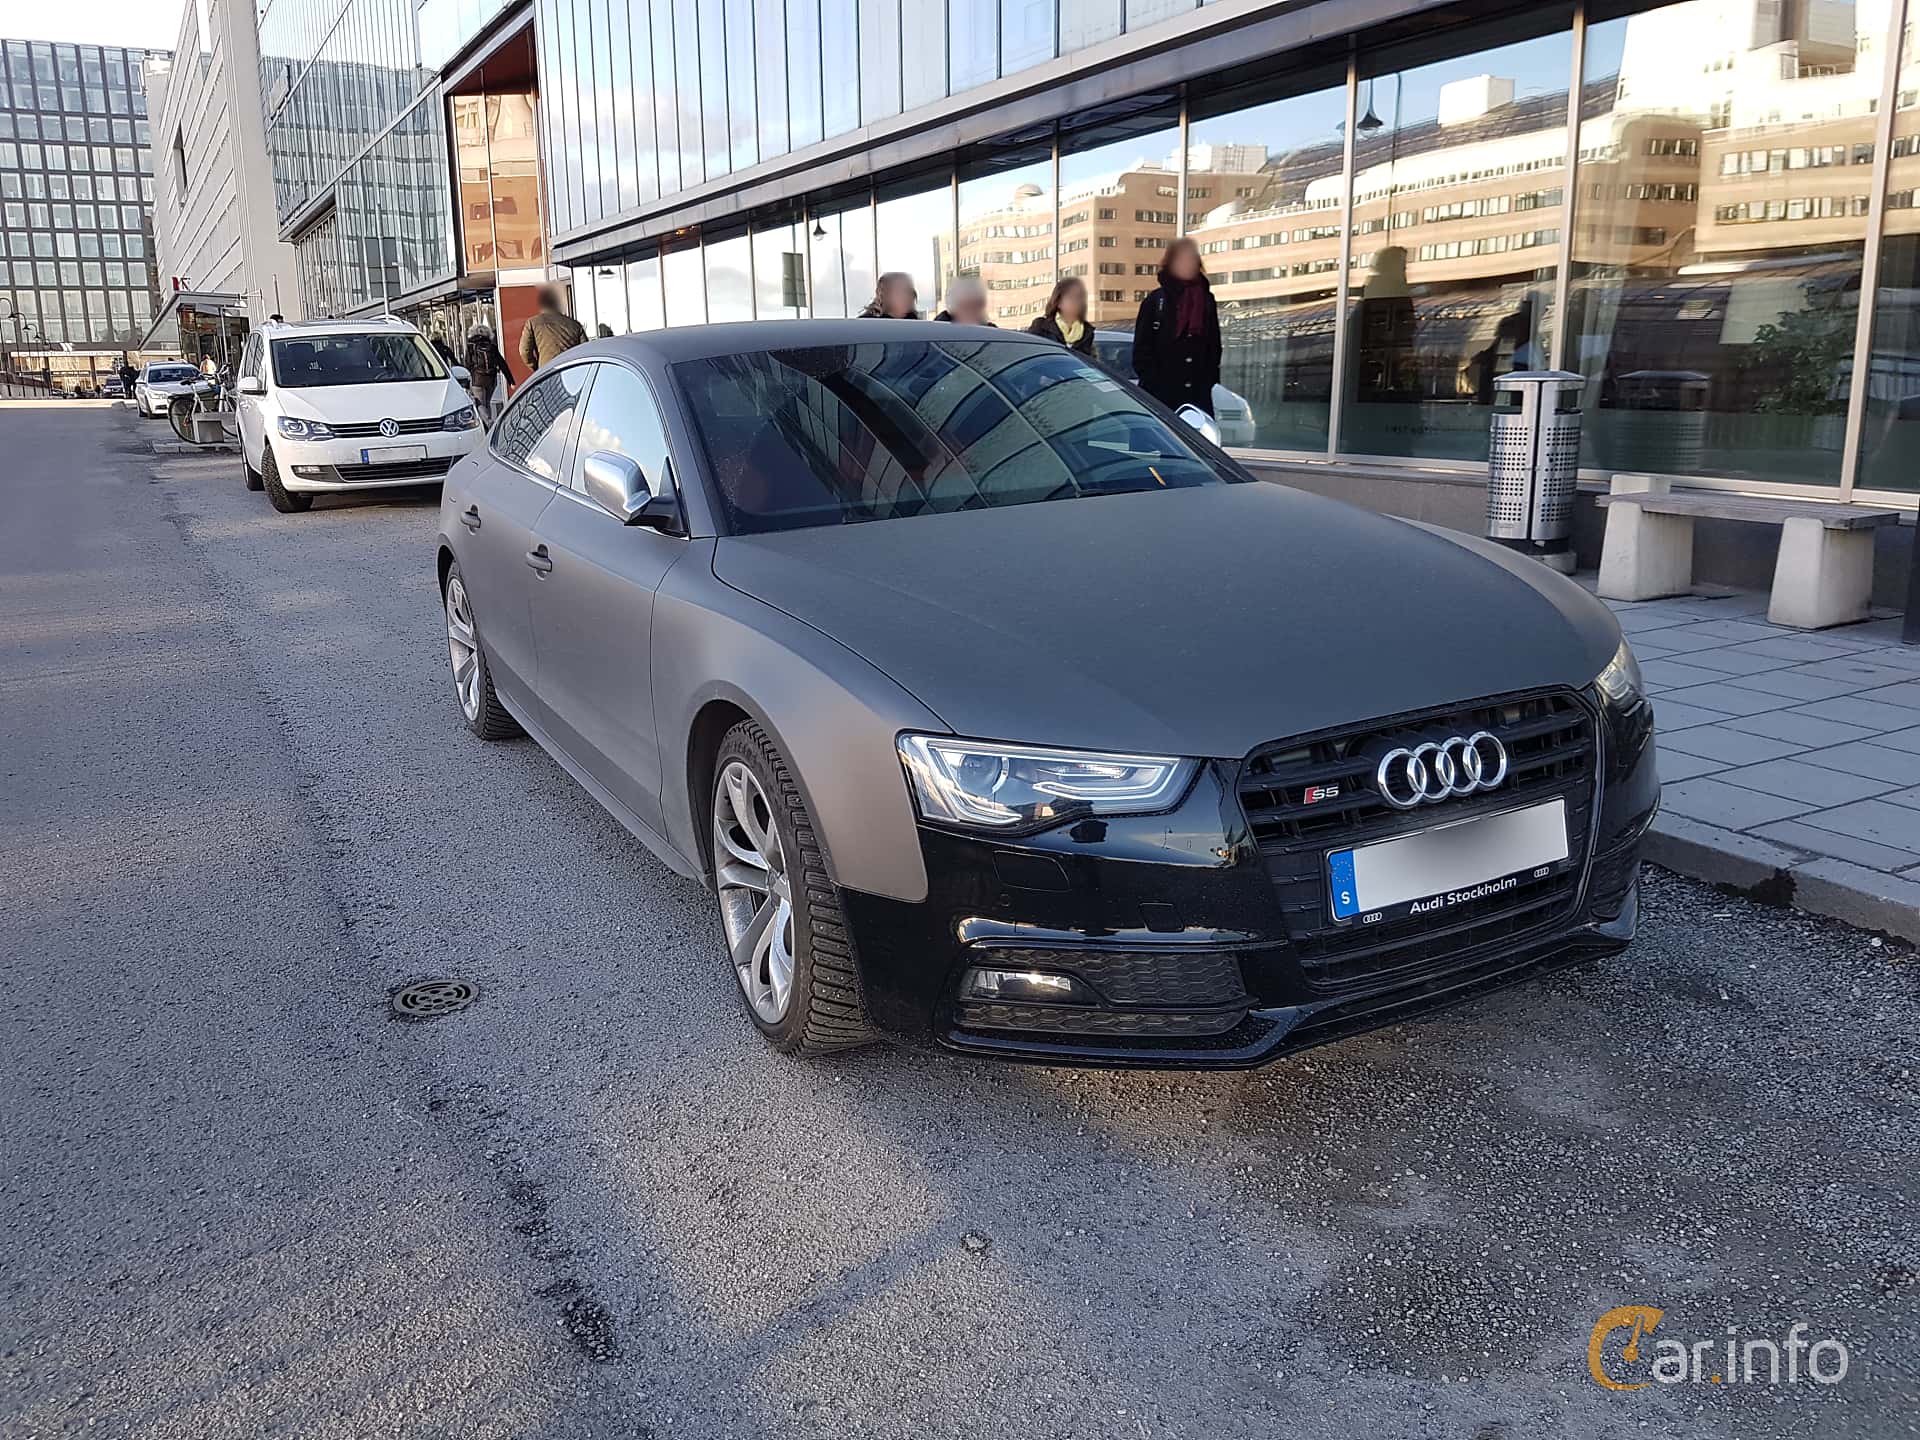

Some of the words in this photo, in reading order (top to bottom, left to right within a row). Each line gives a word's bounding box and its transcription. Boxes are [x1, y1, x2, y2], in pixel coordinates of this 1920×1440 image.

[1311, 786, 1339, 800] S5
[1341, 891, 1351, 905] S
[1409, 896, 1444, 914] Audi
[1447, 877, 1517, 905] Stockholm
